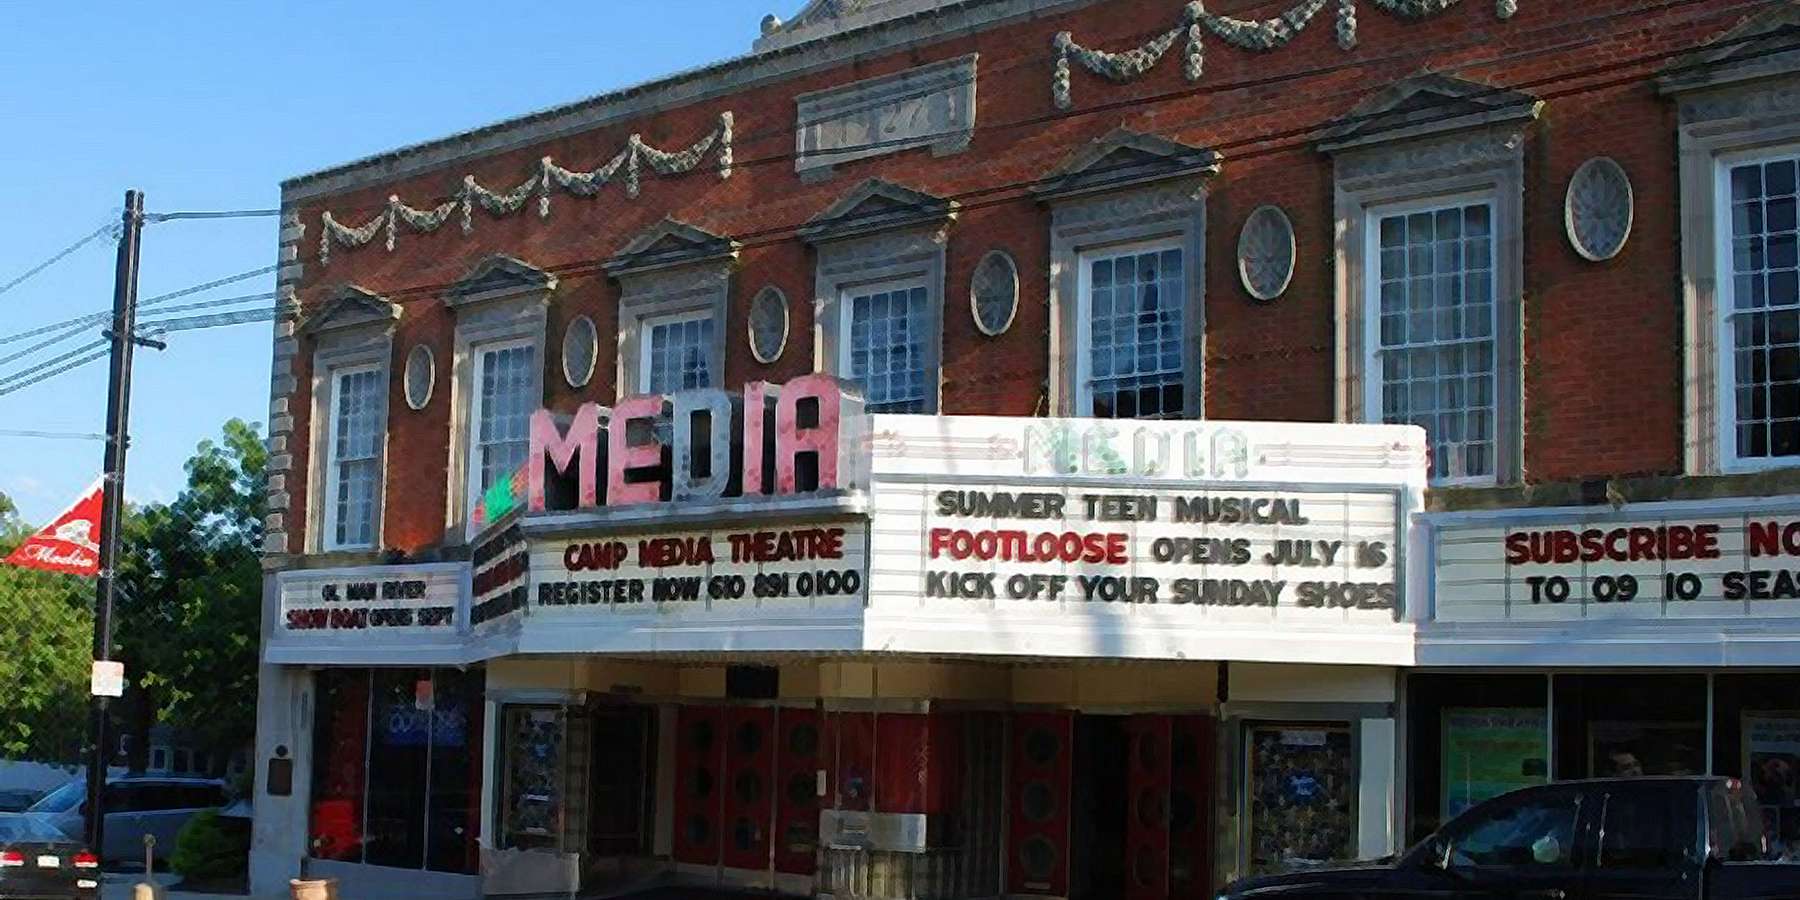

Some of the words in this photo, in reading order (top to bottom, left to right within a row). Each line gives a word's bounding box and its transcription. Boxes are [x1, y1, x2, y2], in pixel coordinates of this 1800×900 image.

[528, 374, 841, 513] MEDIA
[1022, 421, 1249, 479] MEDIA
[935, 489, 1066, 520] SUMMER
[1081, 493, 1157, 522] TEEN
[1172, 495, 1309, 526] MUSICAL
[562, 541, 629, 572] CAMP
[638, 535, 716, 569] MEDIA
[726, 527, 846, 564] THEATRE
[928, 527, 1130, 564] FOOTLOOSE
[1151, 537, 1252, 565] OPENS
[1263, 538, 1343, 567] JULY
[1504, 524, 1721, 566] SUBSCRIBE
[537, 575, 644, 607] REGISTER
[651, 574, 702, 603] NOW
[707, 572, 746, 601] 610
[795, 567, 862, 599] 0100
[925, 569, 997, 600] KICK
[1005, 572, 1069, 601] OFF
[1077, 574, 1160, 604] YOUR
[1170, 577, 1288, 608] SUNDAY
[1294, 580, 1396, 611] SHOES
[1526, 575, 1571, 605] TO
[1592, 573, 1639, 603] 09
[1666, 571, 1703, 601] 10
[1722, 568, 1800, 601] SEA
